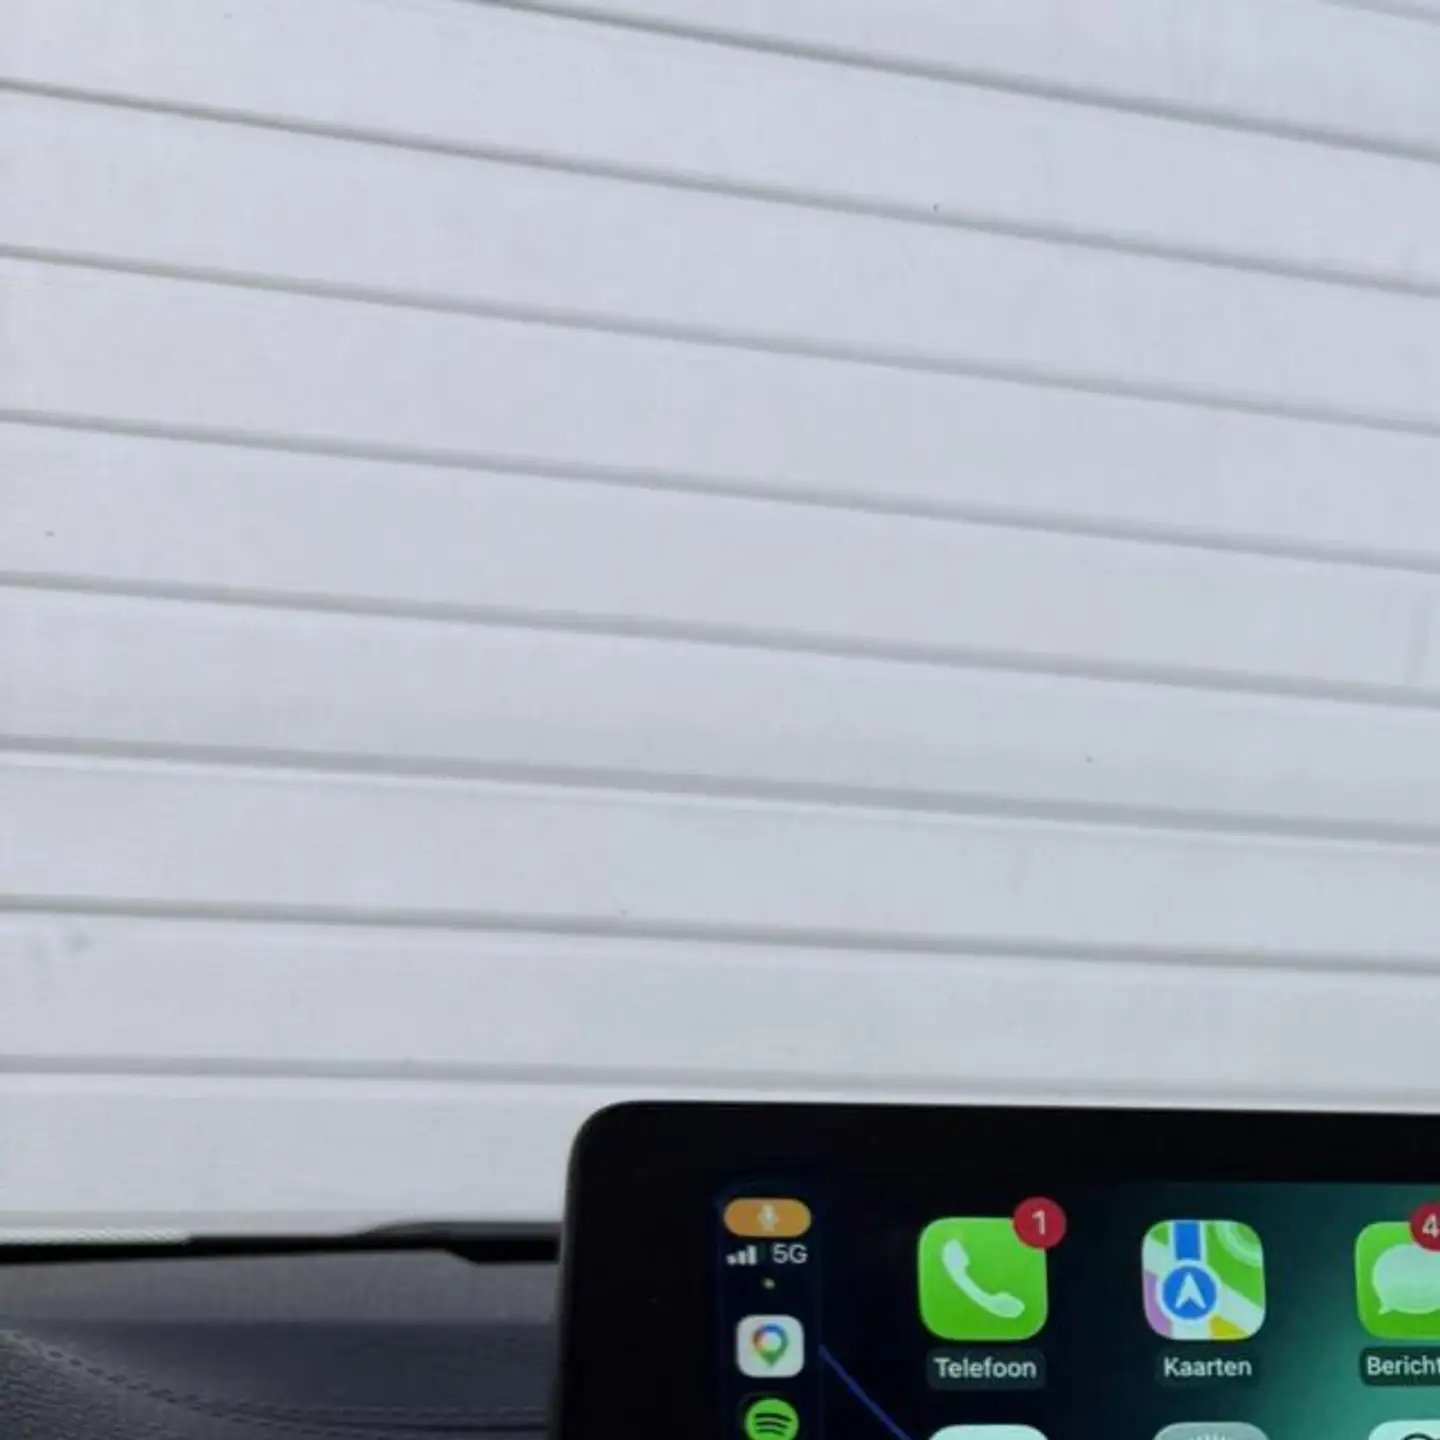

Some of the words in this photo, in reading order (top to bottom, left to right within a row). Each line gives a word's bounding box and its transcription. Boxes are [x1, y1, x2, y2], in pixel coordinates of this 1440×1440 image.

[1034, 1211, 1047, 1235] 1
[773, 1244, 808, 1263] 5G
[934, 1357, 1037, 1379] Telefoon
[1164, 1357, 1252, 1377] Kaarten
